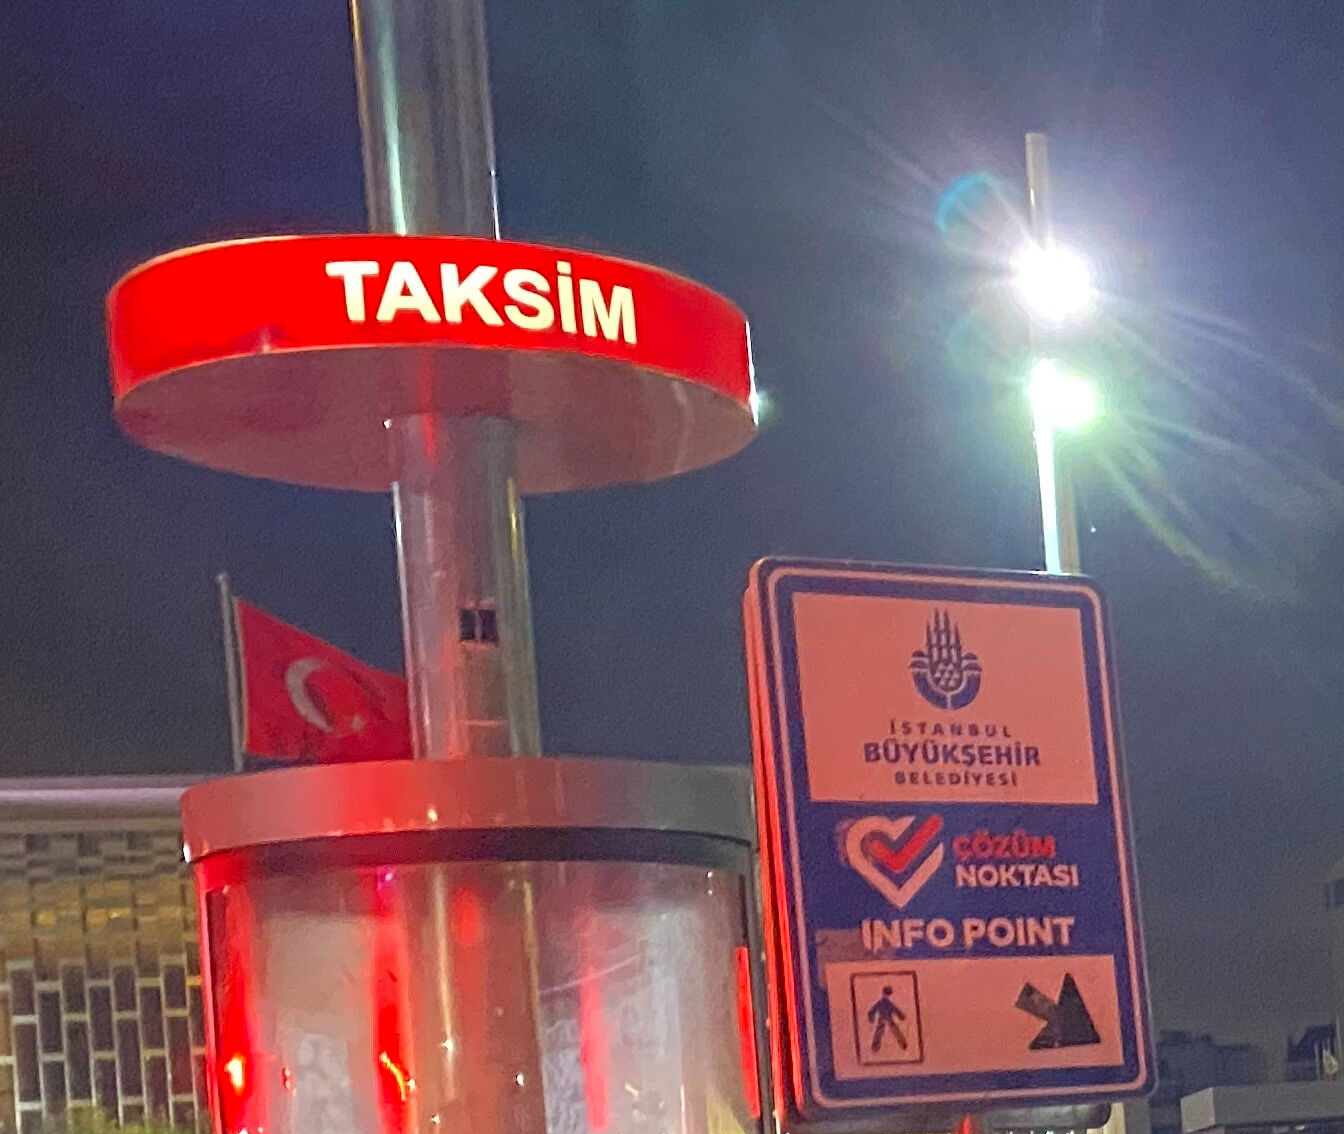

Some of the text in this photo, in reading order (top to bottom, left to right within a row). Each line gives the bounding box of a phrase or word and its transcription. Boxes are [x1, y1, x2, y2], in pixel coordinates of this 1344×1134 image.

[325, 260, 638, 345] TAKSİM
[889, 718, 1012, 738] İSTANBUL
[863, 737, 1041, 767] BÜYÜKŞEHİR
[894, 770, 1018, 787] BELEDİYESİ
[952, 828, 1056, 860] ÇÖZÜM
[955, 863, 1080, 888] NOKTASI
[861, 914, 1075, 952] INFO POINT
